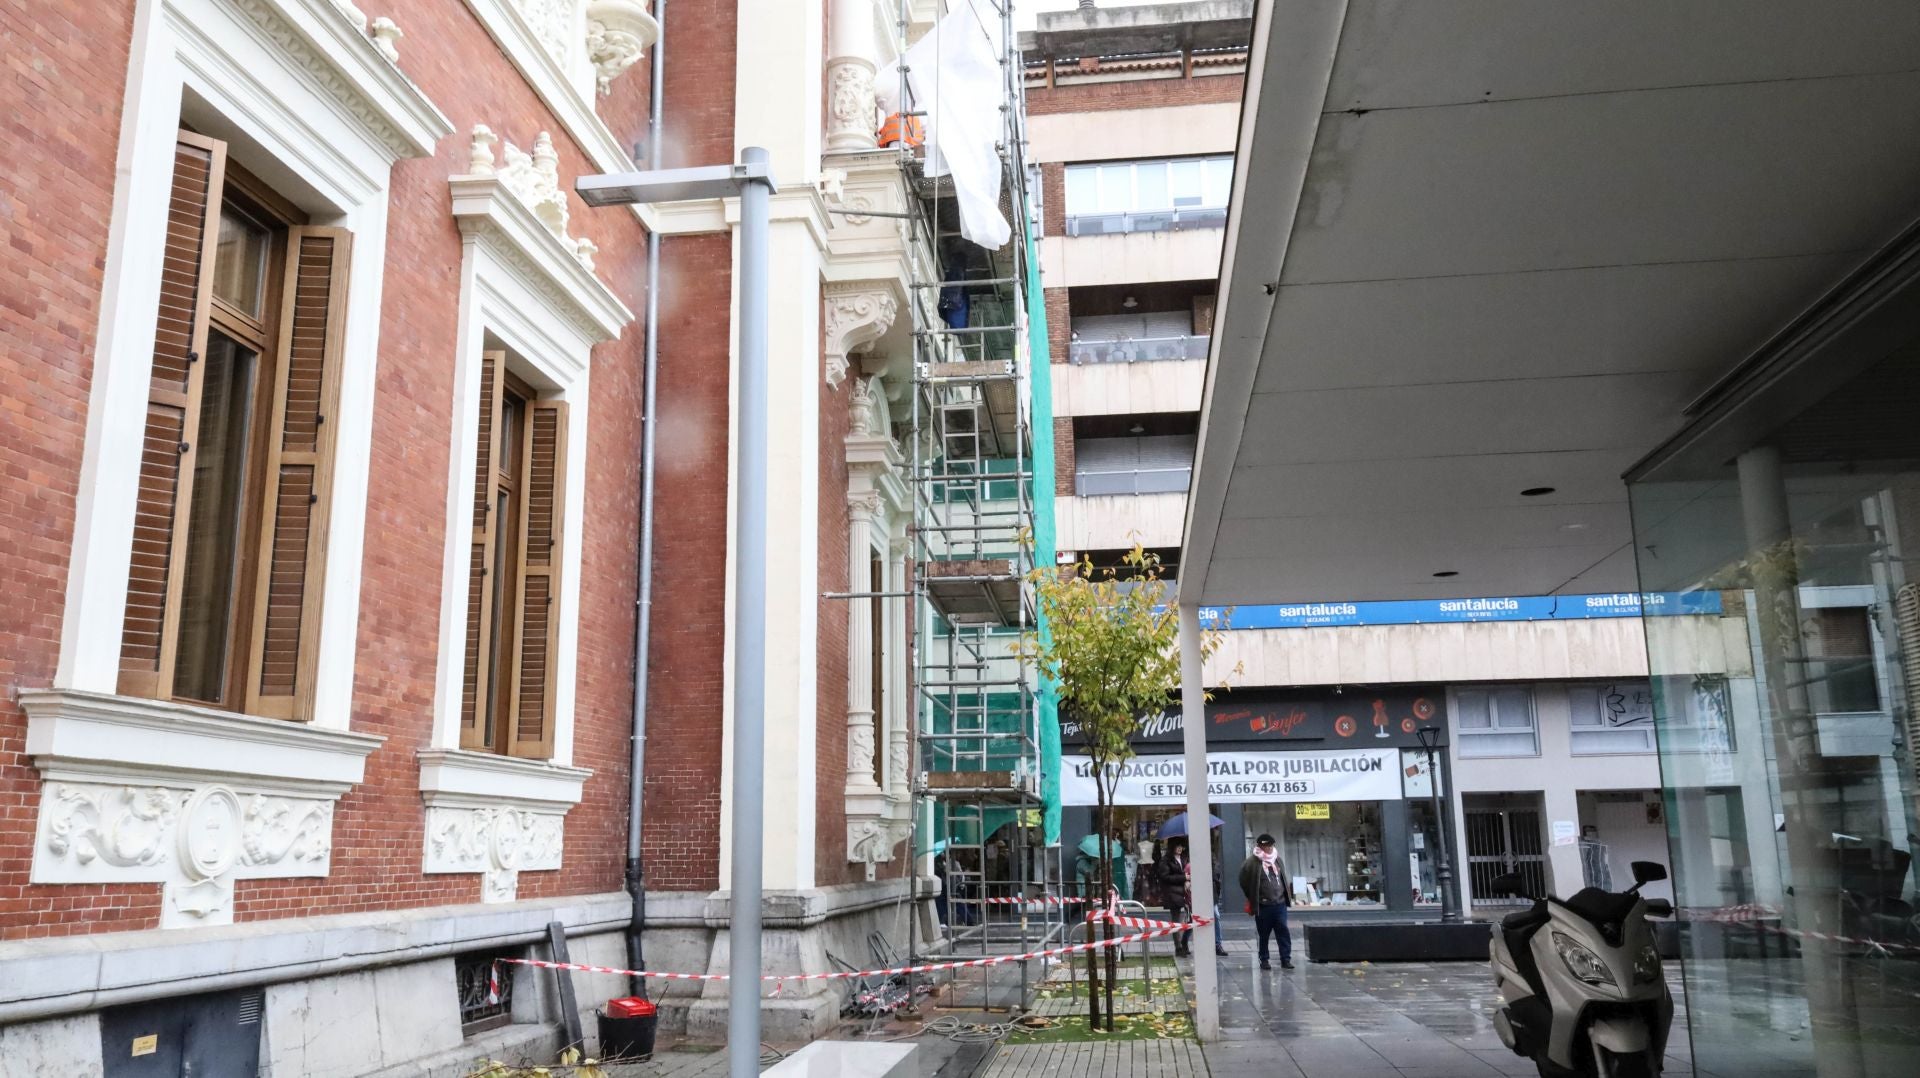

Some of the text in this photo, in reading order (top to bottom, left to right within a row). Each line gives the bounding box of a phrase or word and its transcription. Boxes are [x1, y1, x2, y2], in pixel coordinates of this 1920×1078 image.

[1279, 603, 1357, 617] santalucía
[1244, 760, 1280, 775] POR
[1283, 754, 1382, 778] JUBILACIÓN
[1150, 785, 1164, 796] SE
[1235, 783, 1257, 794] 667
[1261, 782, 1281, 794] 421
[1284, 781, 1308, 793] 863
